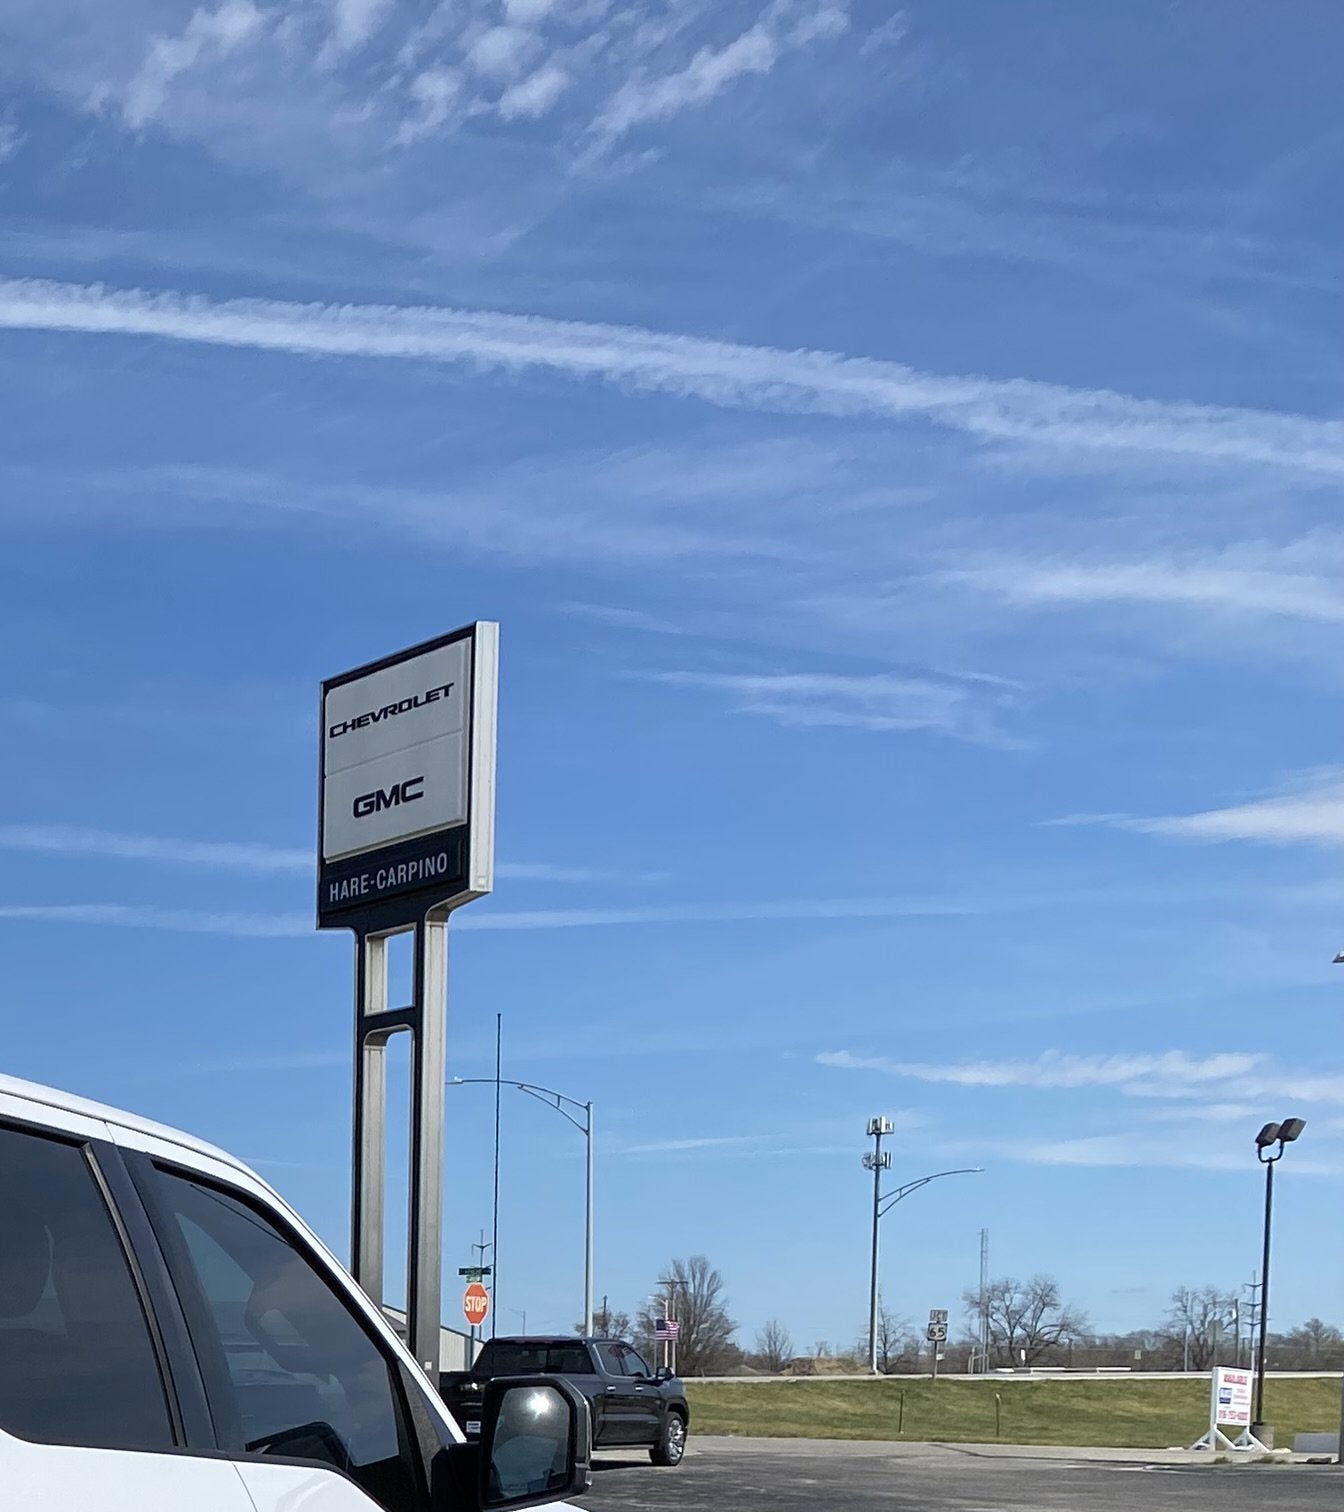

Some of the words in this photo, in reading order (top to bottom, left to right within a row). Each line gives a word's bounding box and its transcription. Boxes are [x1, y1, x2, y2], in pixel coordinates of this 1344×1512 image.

[329, 682, 455, 739] CHEVROLET
[352, 776, 425, 819] GMC
[329, 852, 449, 903] HARE-CARPINO
[465, 1295, 487, 1313] STOP
[929, 1326, 945, 1338] 65
